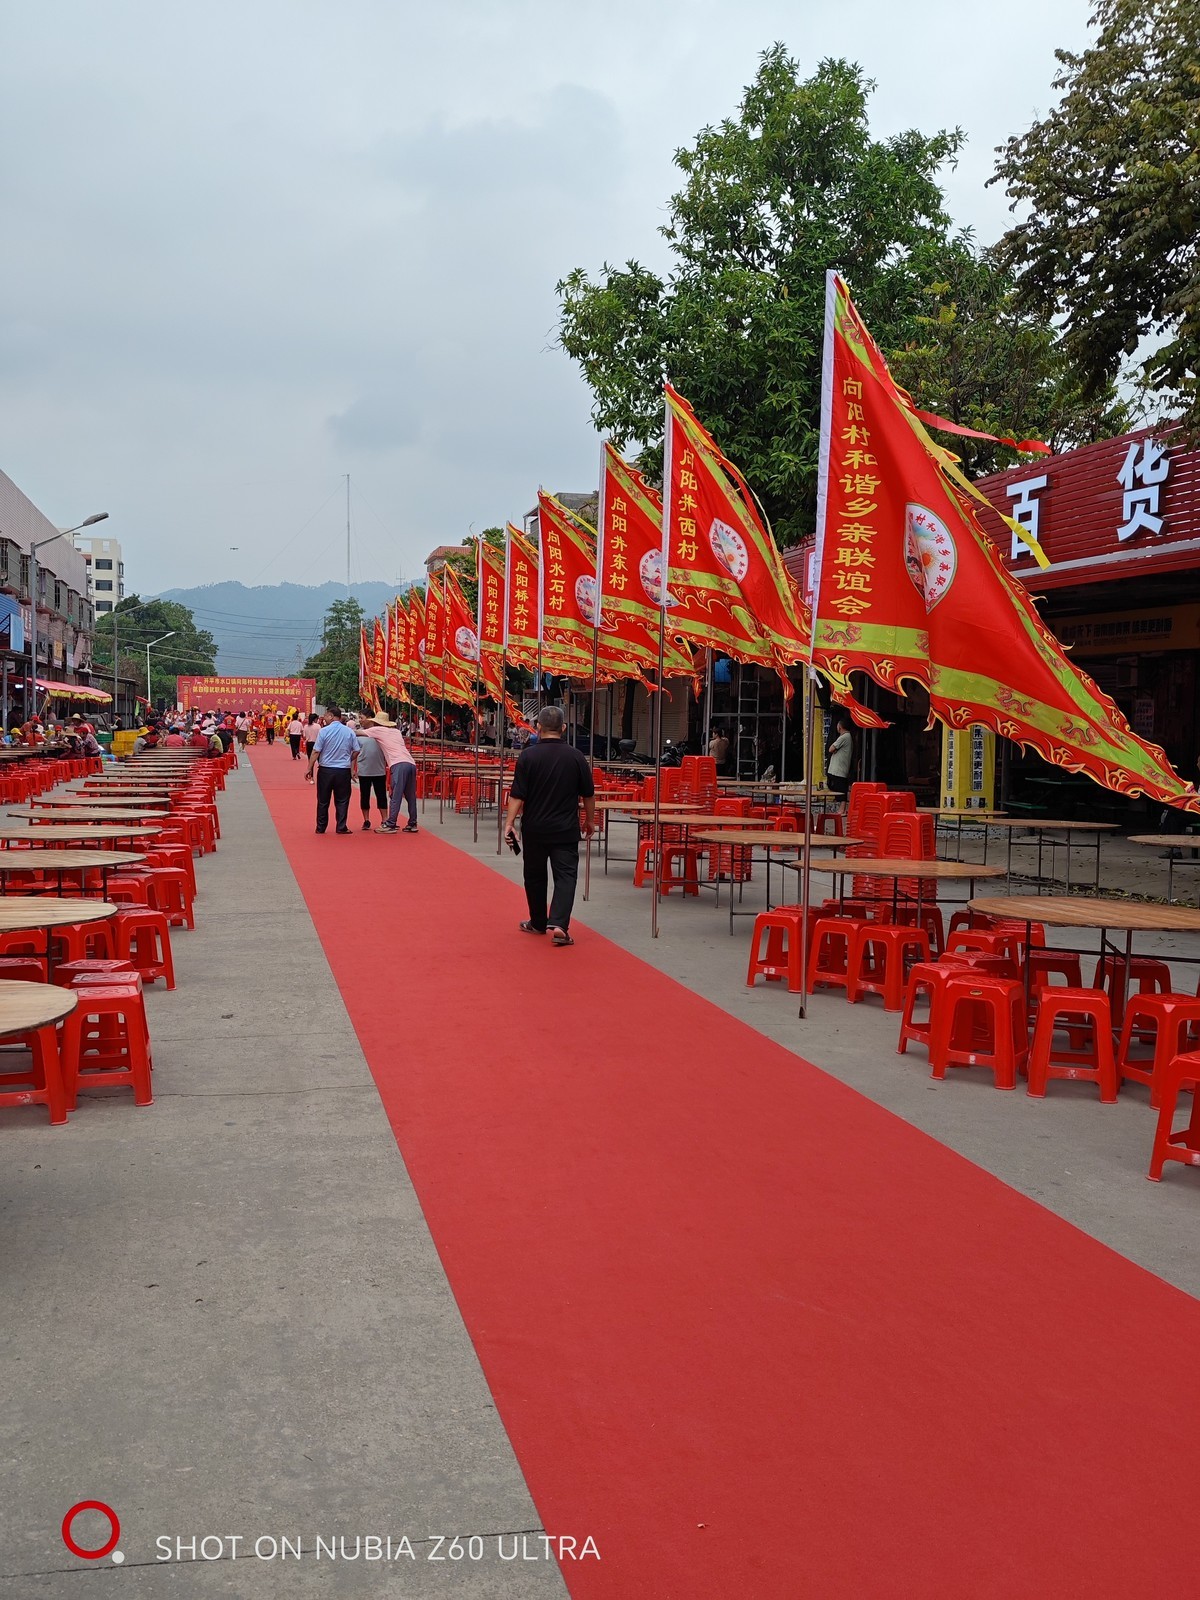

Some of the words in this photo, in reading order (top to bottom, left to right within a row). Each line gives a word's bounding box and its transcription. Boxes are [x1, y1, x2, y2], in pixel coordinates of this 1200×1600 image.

[677, 448, 699, 562] 向阳井西村
[830, 376, 881, 615] 向阳村和谐乡亲联谊会
[1006, 437, 1171, 560] 百货
[547, 530, 565, 611] 向阳水石村
[609, 497, 628, 591] 向阳井东村
[485, 575, 499, 638] 向阳竹溪村
[514, 561, 529, 631] 向阳桥头村
